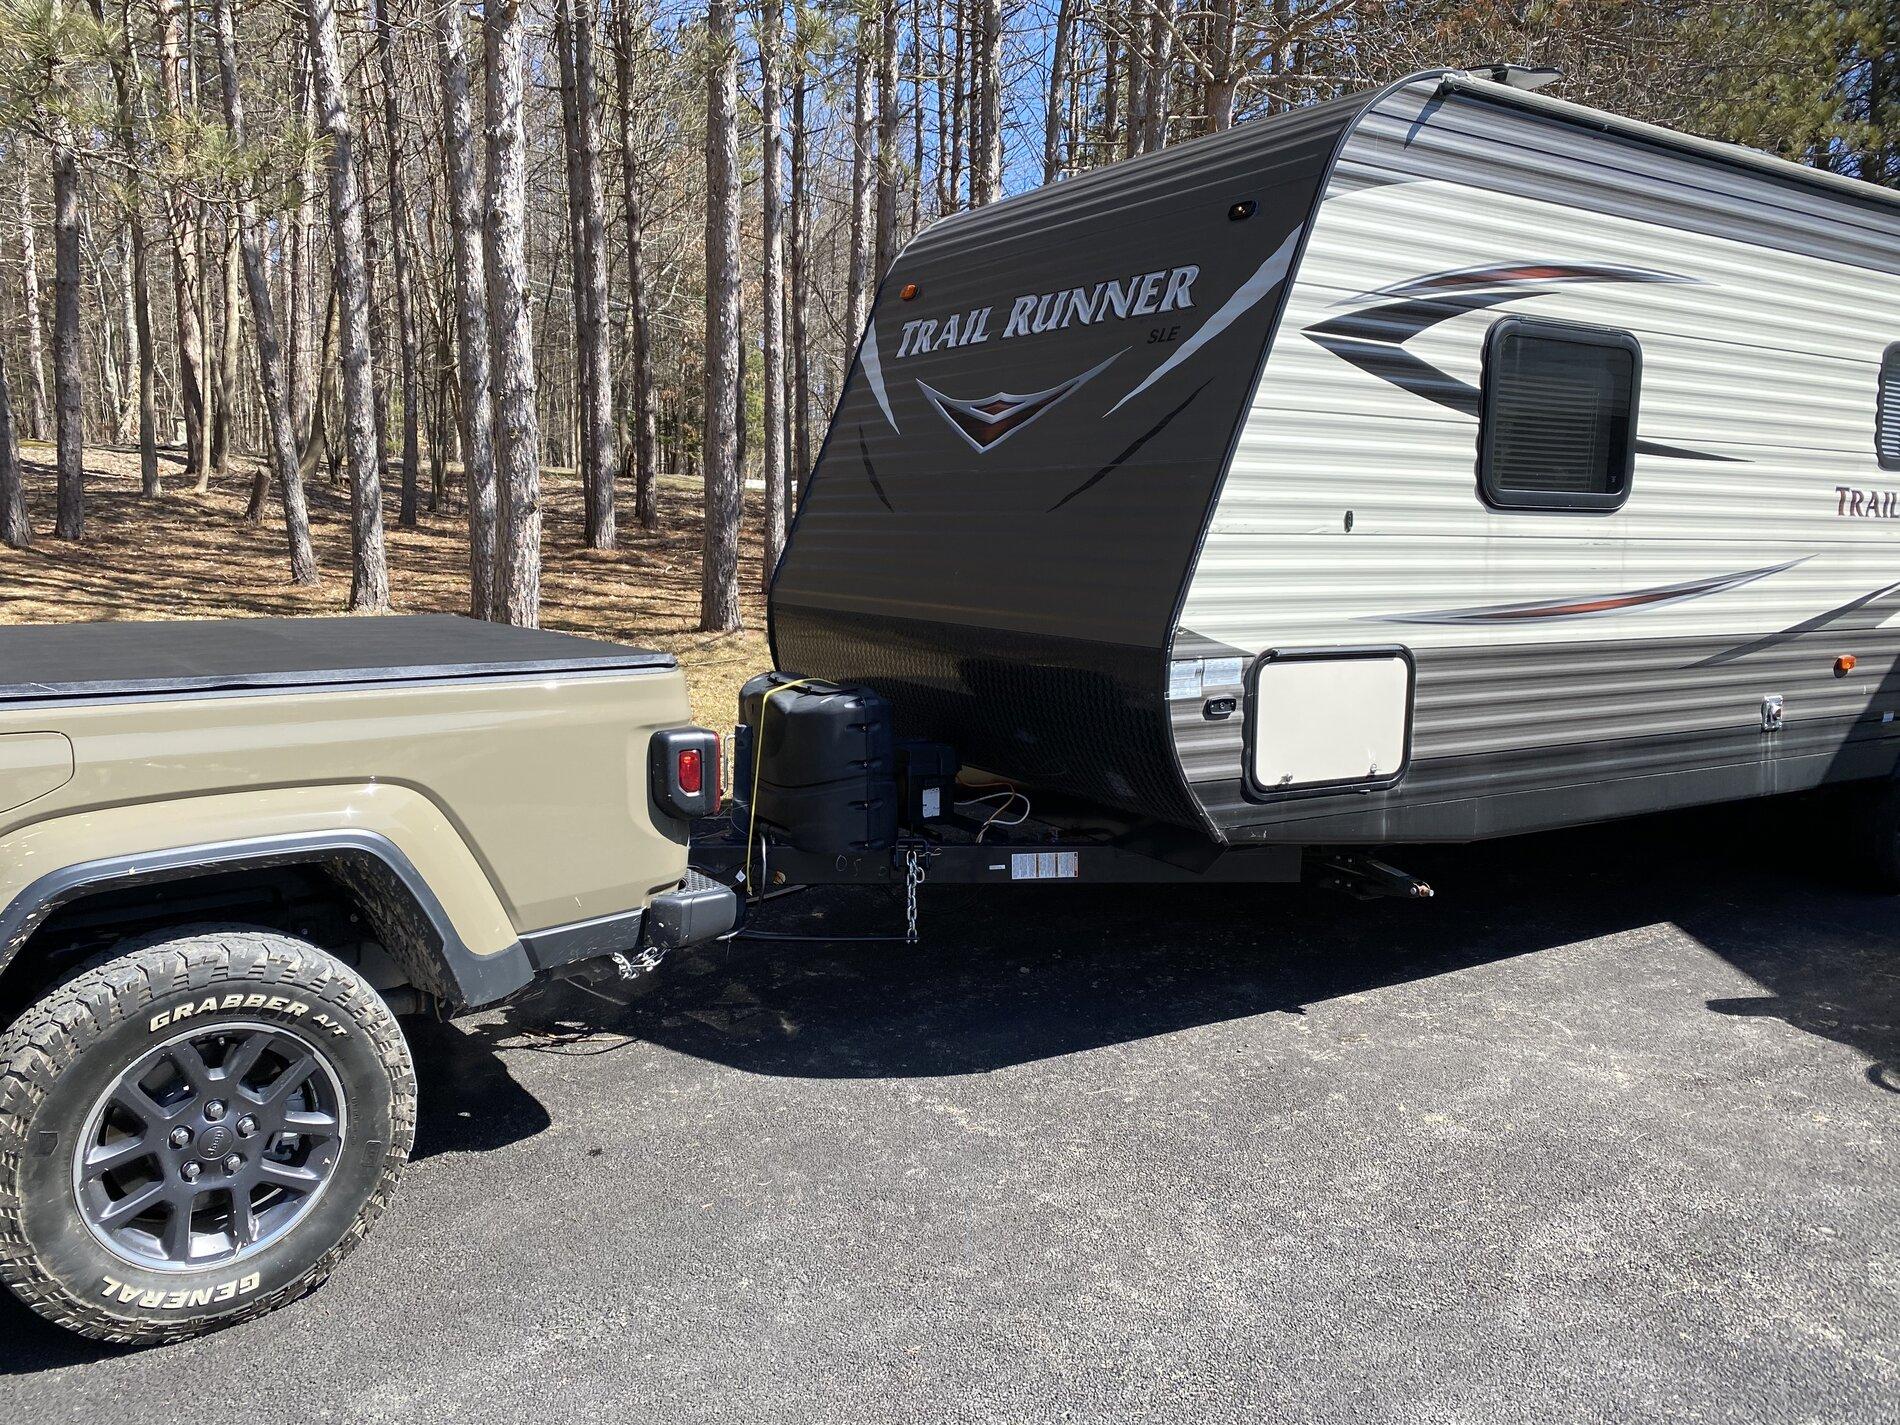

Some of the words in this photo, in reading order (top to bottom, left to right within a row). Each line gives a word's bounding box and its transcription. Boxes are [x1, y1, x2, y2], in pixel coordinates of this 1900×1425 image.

[895, 306, 994, 359] TRAIL
[1001, 263, 1201, 340] RUNNER
[1147, 325, 1181, 344] SLE
[1835, 486, 1900, 519] TRAIL
[149, 993, 311, 1034] GRABBER
[312, 1013, 348, 1038] A/T
[101, 1271, 261, 1310] GENERAL
